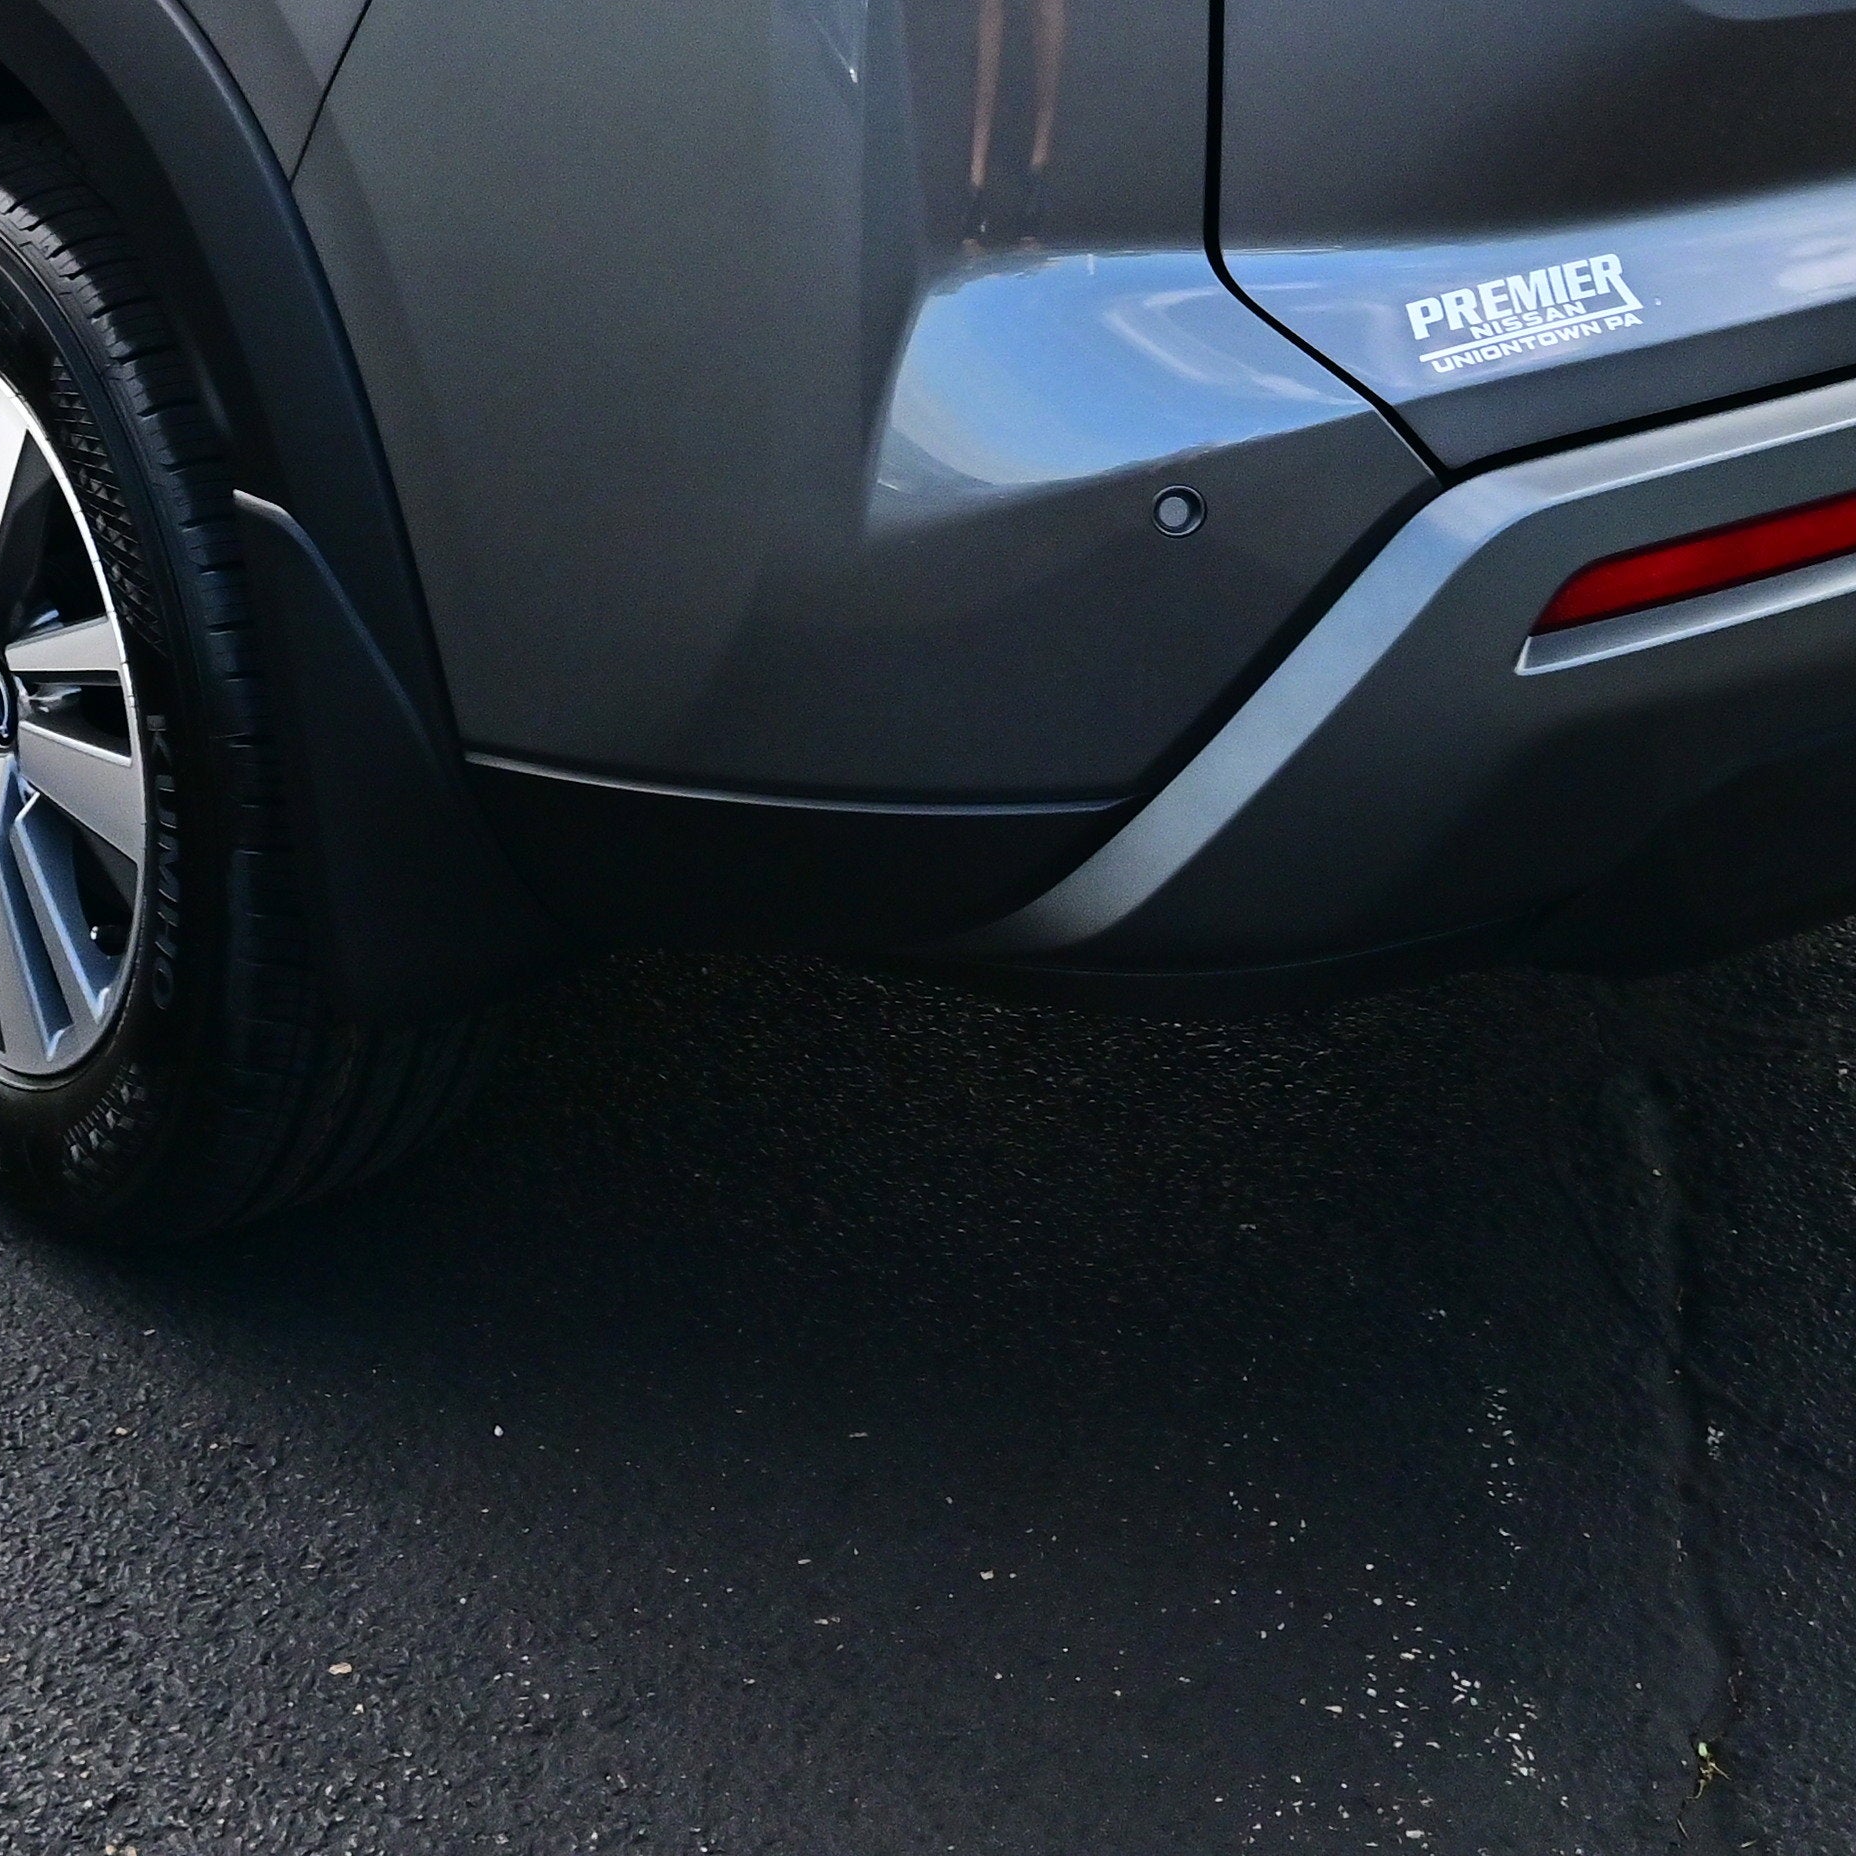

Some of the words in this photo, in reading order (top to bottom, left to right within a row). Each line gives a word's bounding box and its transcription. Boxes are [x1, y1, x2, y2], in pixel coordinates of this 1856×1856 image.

[1405, 253, 1643, 341] PREMIER
[1469, 300, 1587, 340] NISSAN
[1431, 321, 1602, 374] UNIONTOWN
[1604, 312, 1644, 331] PA
[146, 714, 181, 1011] KUMHO
